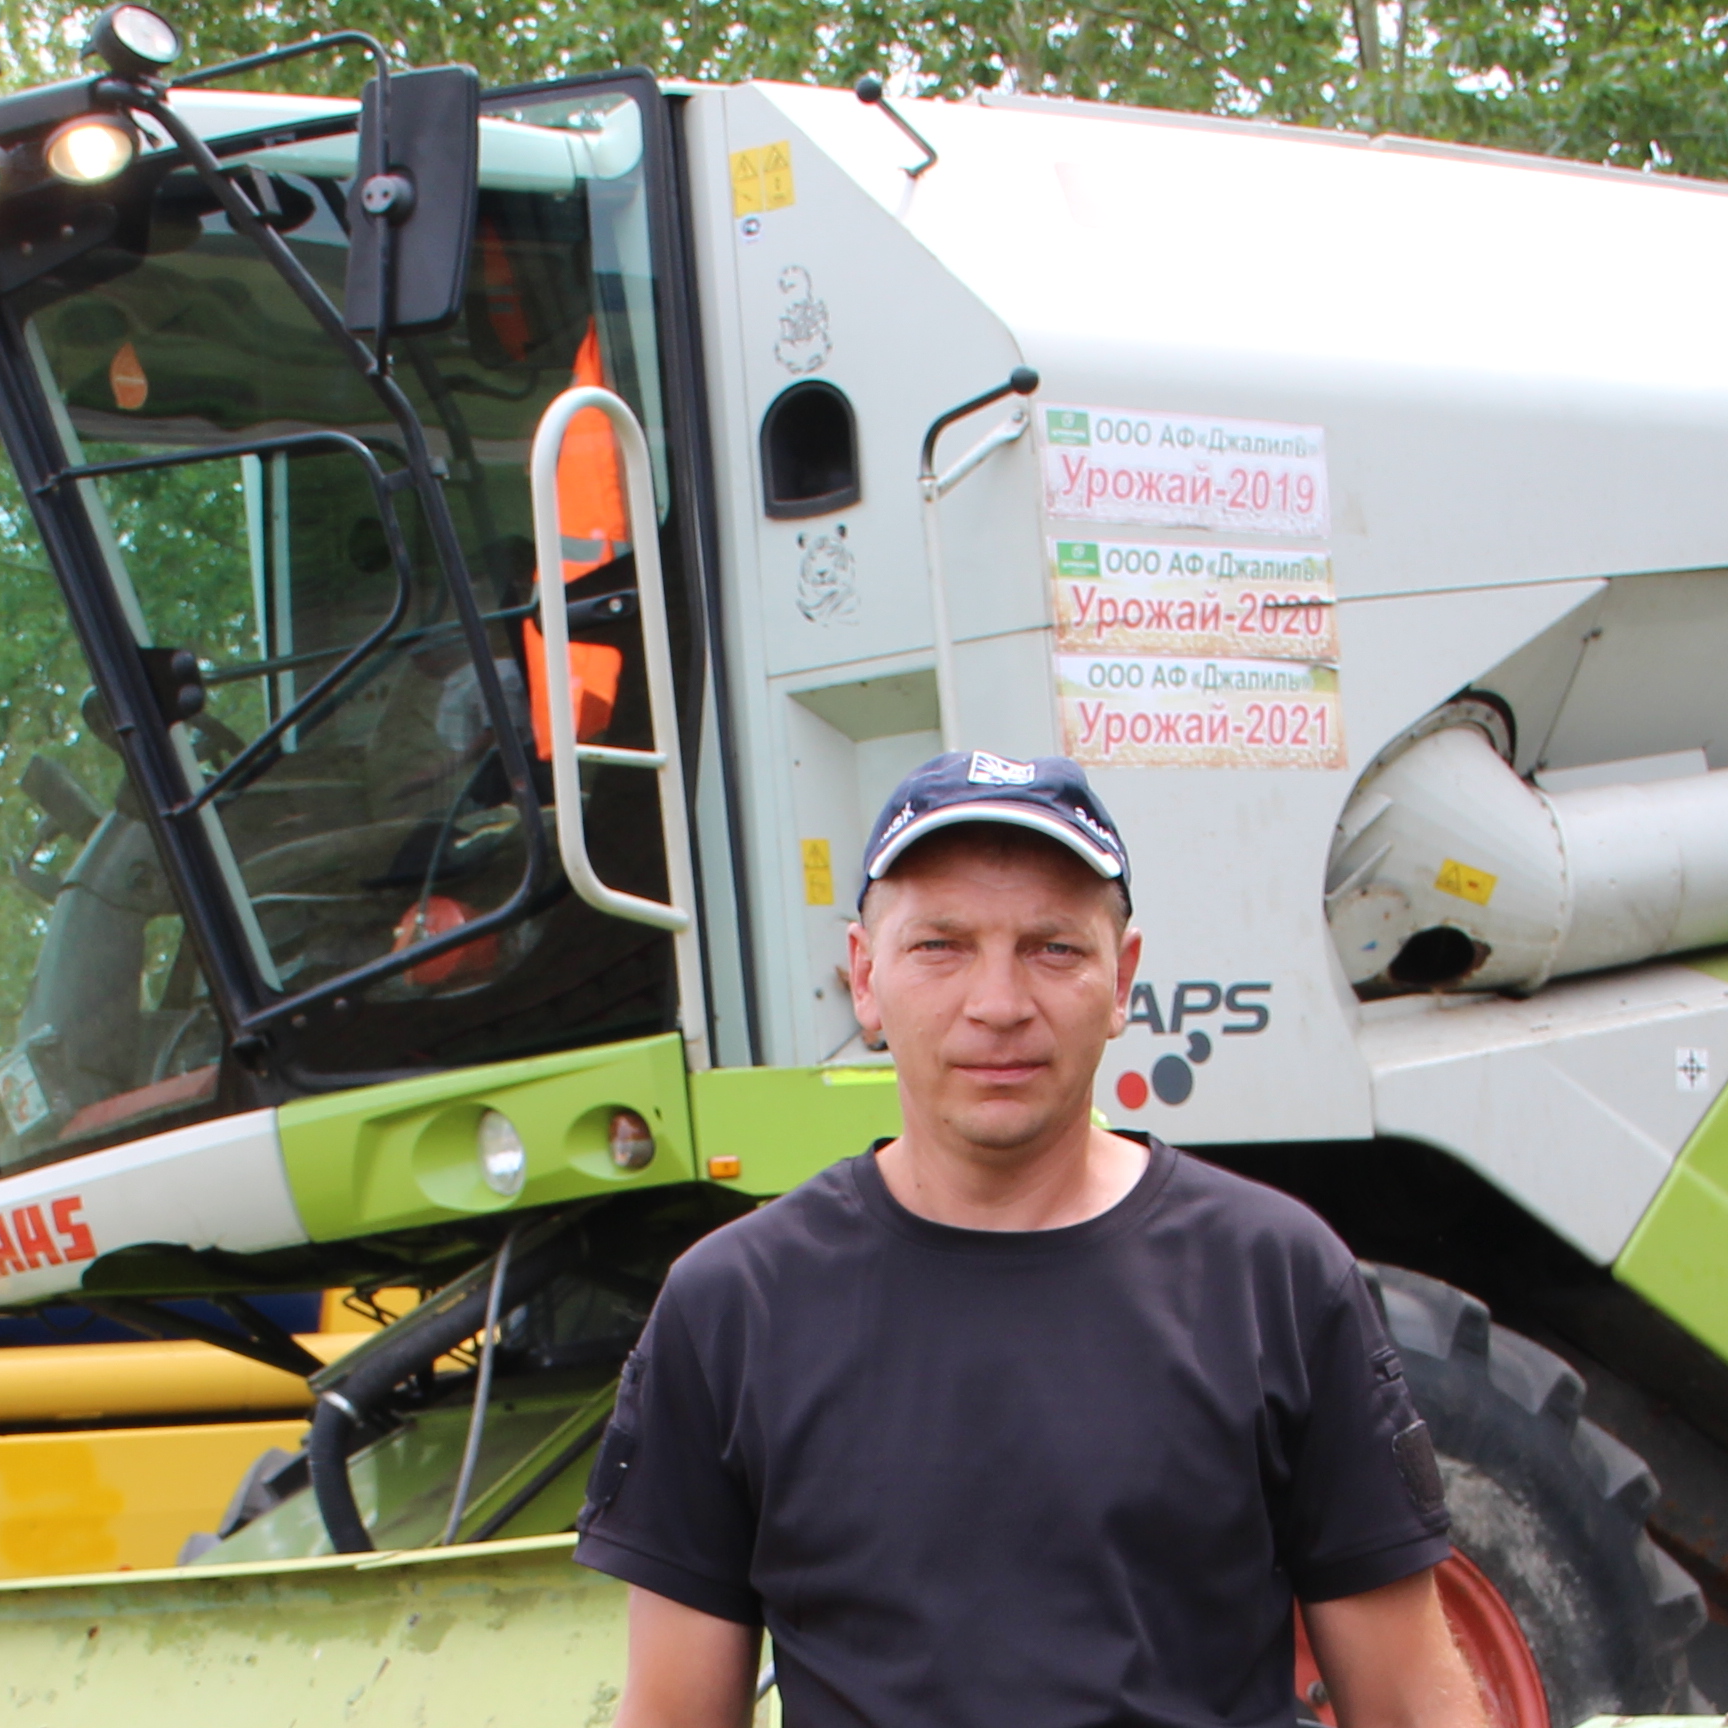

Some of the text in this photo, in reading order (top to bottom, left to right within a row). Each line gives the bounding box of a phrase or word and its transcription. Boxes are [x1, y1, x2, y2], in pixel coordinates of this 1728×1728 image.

[1095, 418, 1152, 447] ООО
[1060, 454, 1315, 515] Урожай-2019
[1105, 549, 1161, 574] ООО
[1071, 585, 1324, 638] Урожай-2020
[1088, 663, 1144, 689] ООО
[1078, 701, 1328, 755] Урожай-2021
[1126, 981, 1273, 1034] APS
